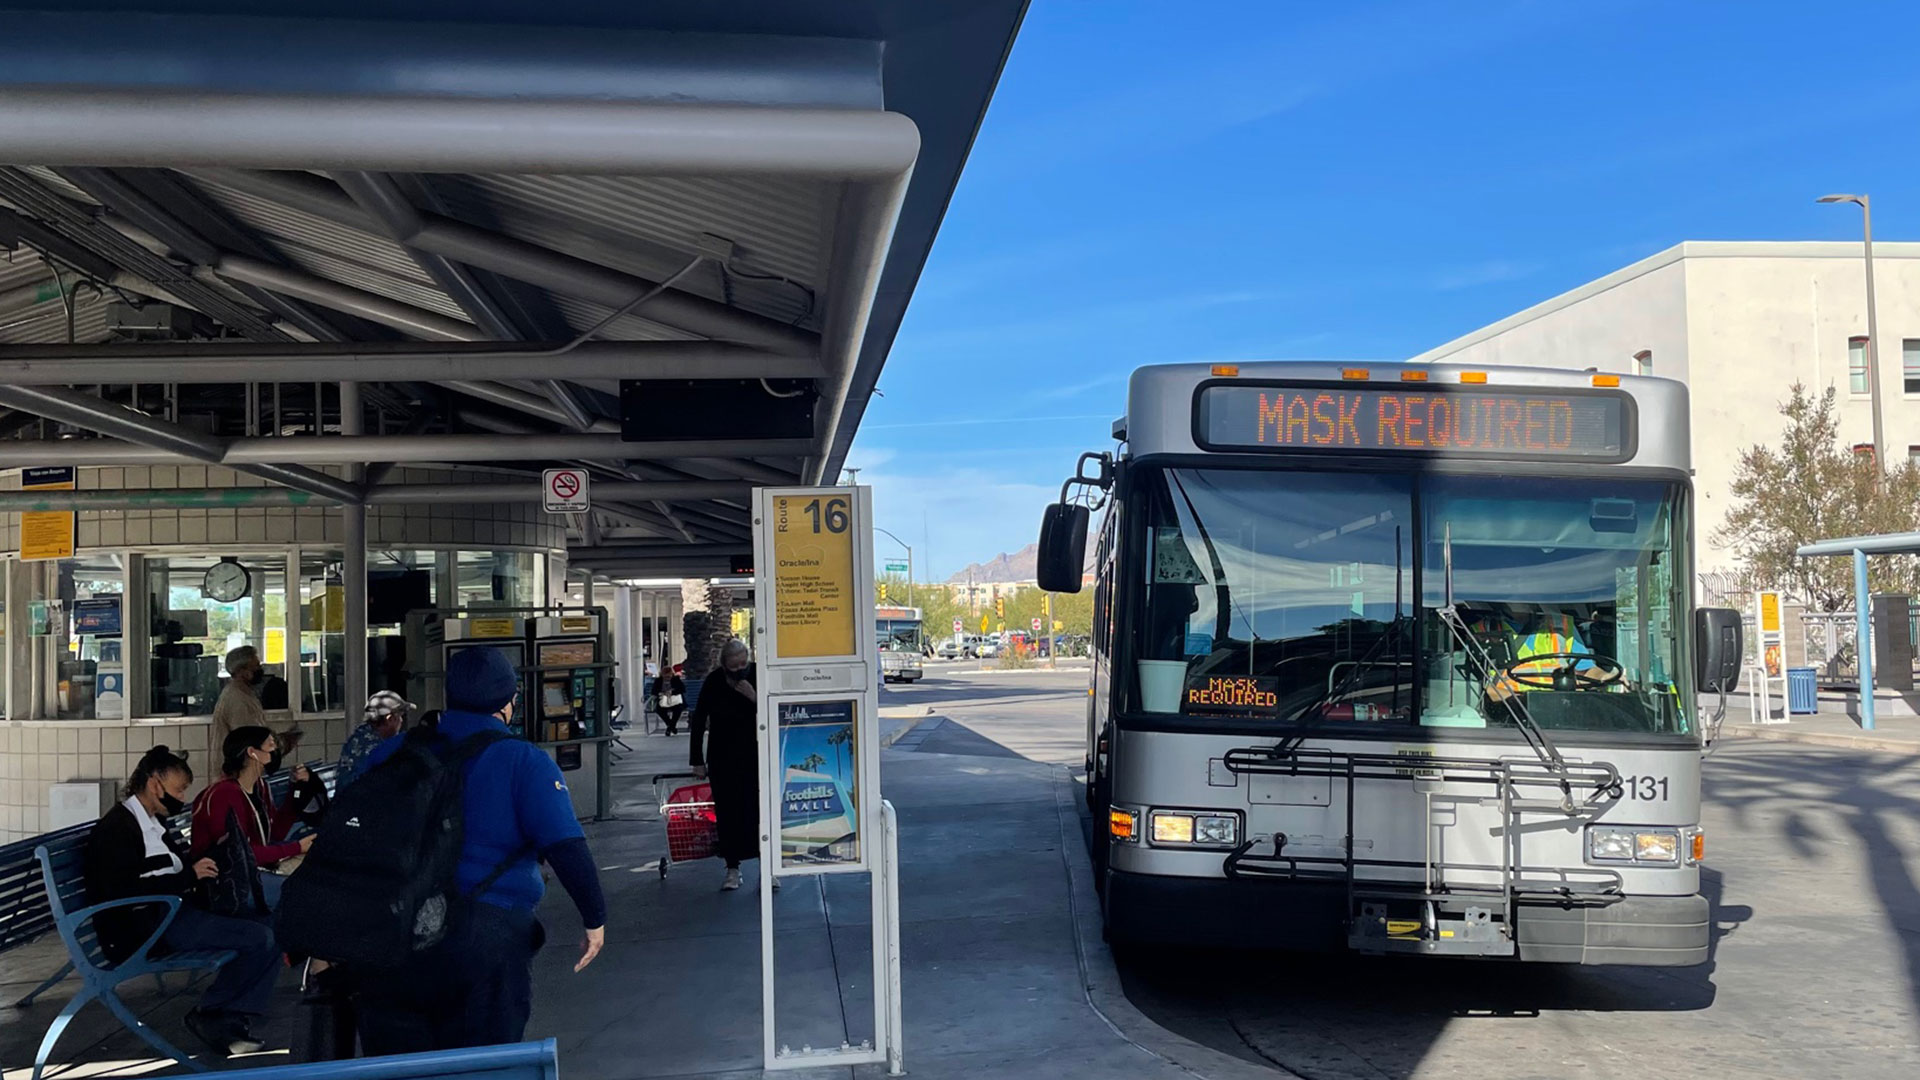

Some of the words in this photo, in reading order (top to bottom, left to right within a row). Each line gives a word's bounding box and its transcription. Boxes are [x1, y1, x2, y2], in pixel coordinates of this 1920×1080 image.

[1258, 393, 1361, 444] MASK
[1378, 396, 1572, 449] REQUIRED
[778, 499, 788, 533] Route
[804, 498, 849, 533] 16
[1189, 688, 1277, 706] REQUIRED
[1209, 677, 1257, 693] MASK
[789, 800, 831, 812] MALL
